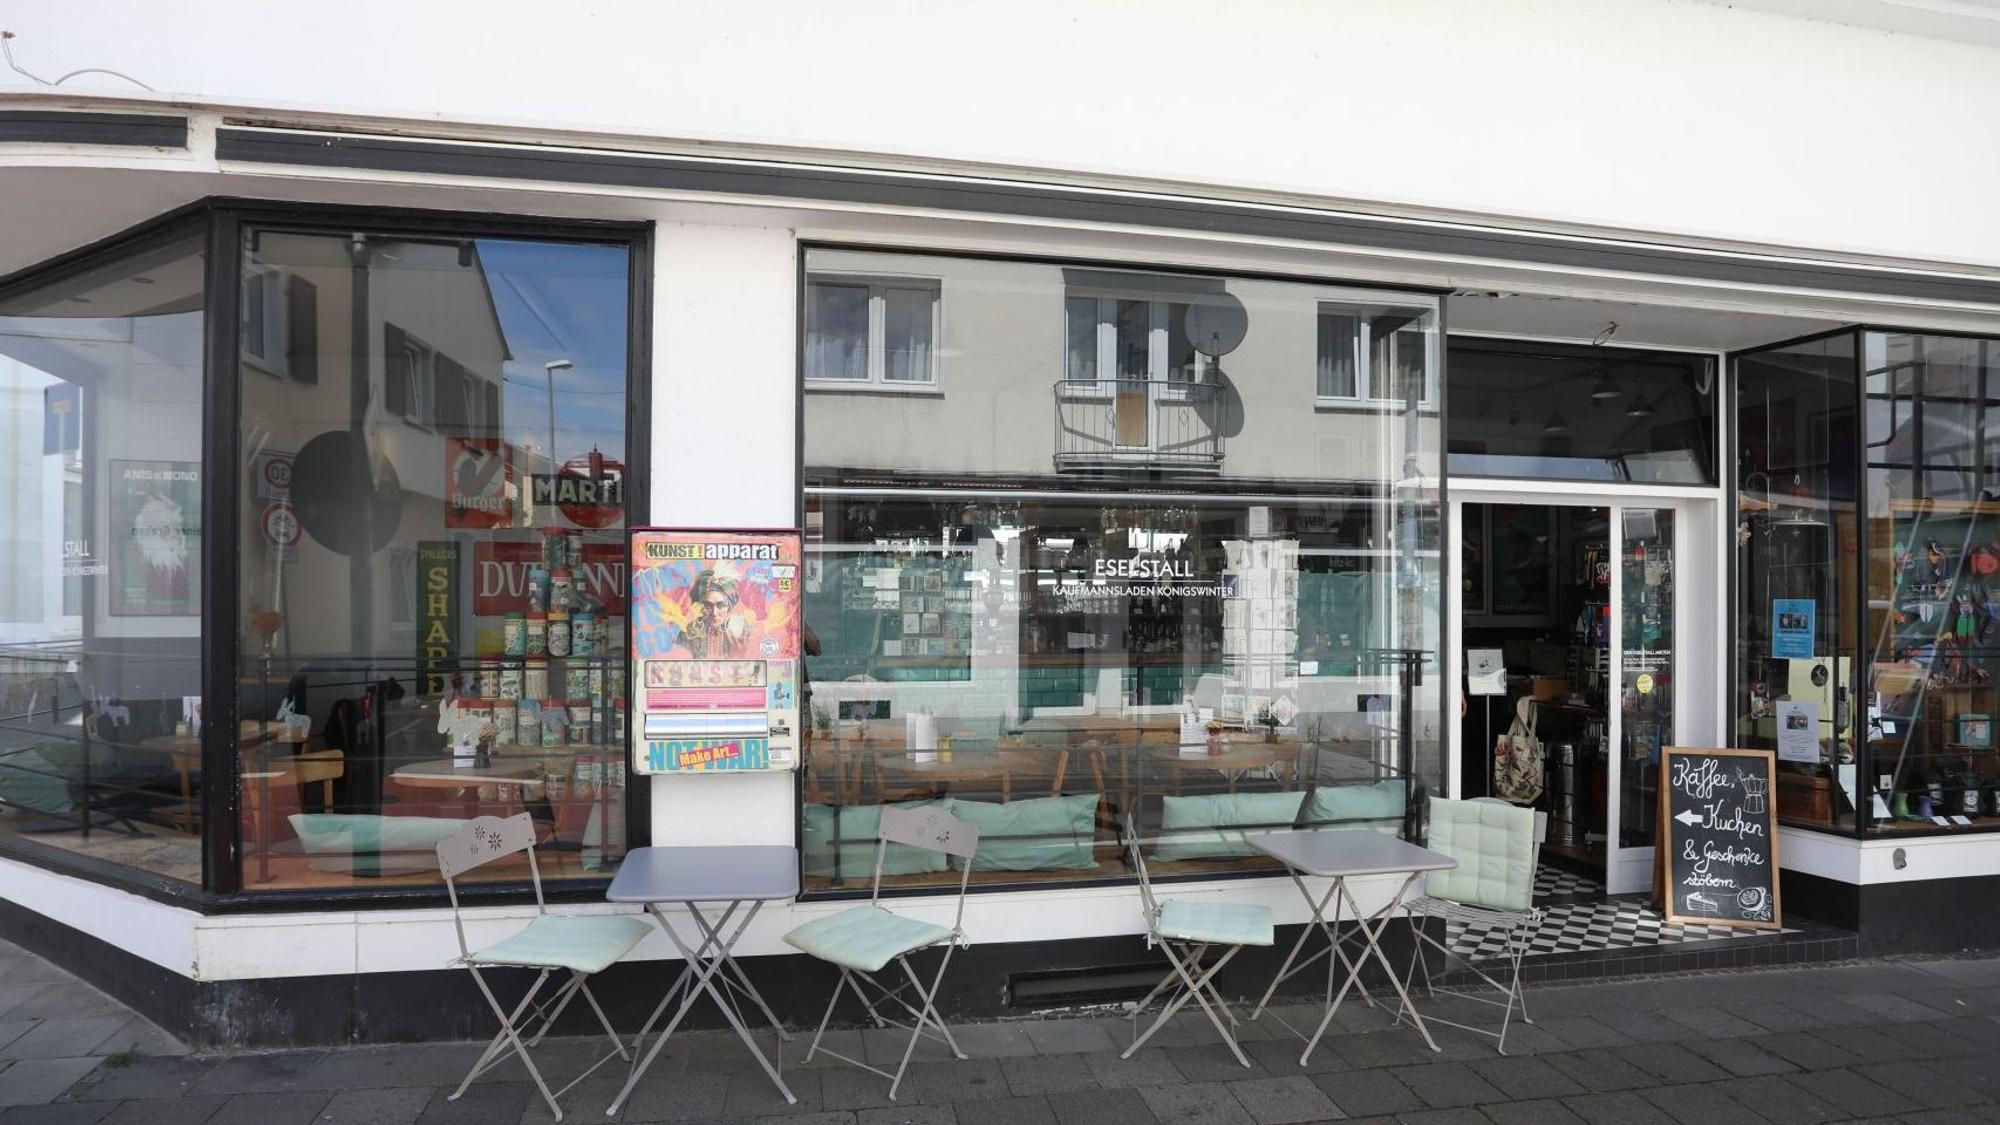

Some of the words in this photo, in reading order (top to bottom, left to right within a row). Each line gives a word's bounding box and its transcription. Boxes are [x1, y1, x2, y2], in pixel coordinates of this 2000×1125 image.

[706, 544, 777, 558] apparat
[1095, 559, 1194, 577] ESELSTALL
[1053, 585, 1155, 596] KAUFMANNSLADEN
[680, 751, 712, 766] Make
[1702, 799, 1764, 840] Kuchen
[1694, 840, 1764, 874] Geschenke
